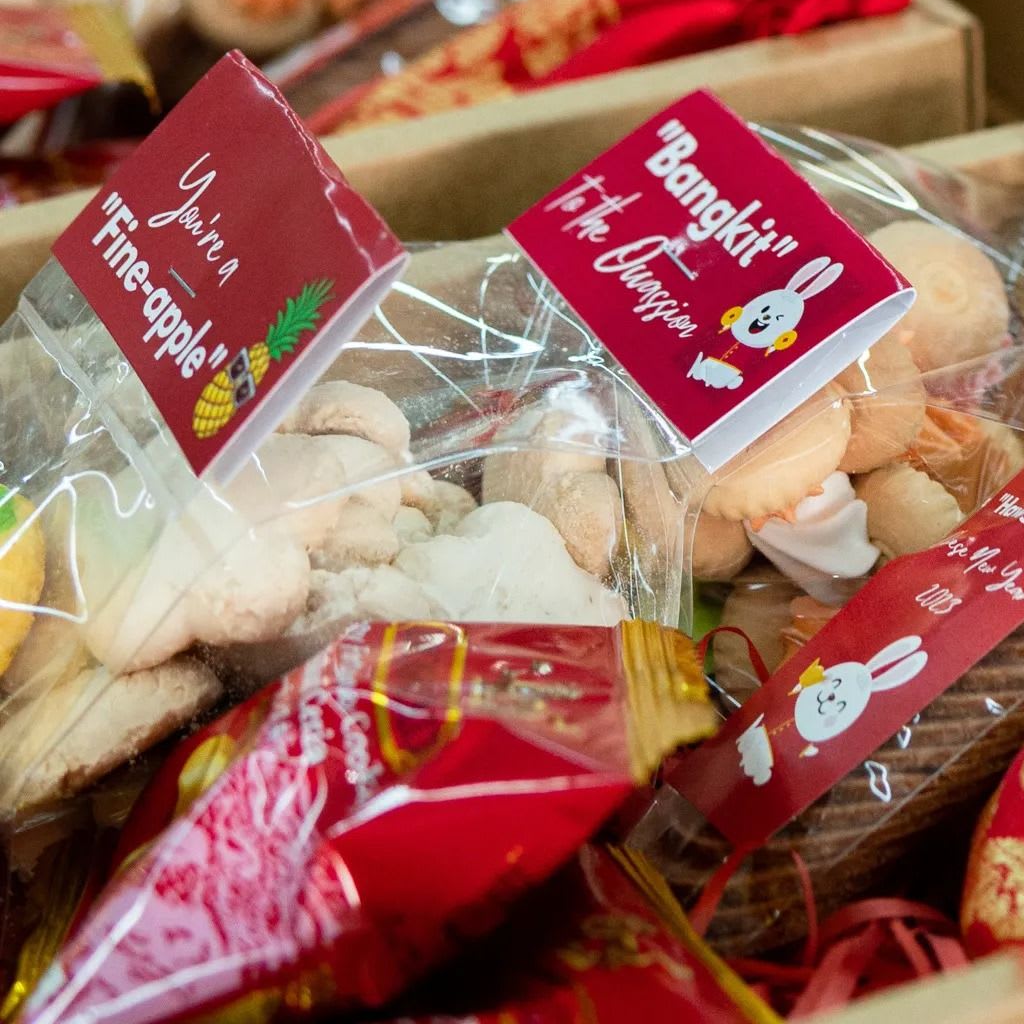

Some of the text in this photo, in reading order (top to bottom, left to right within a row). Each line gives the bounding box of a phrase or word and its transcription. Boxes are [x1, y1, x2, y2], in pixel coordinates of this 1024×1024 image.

[147, 152, 240, 288] You're a
[644, 118, 799, 268] "Bangkit"
[91, 191, 229, 379] "Fine-apple"
[914, 583, 963, 615] 2023
[963, 545, 1001, 575] New
